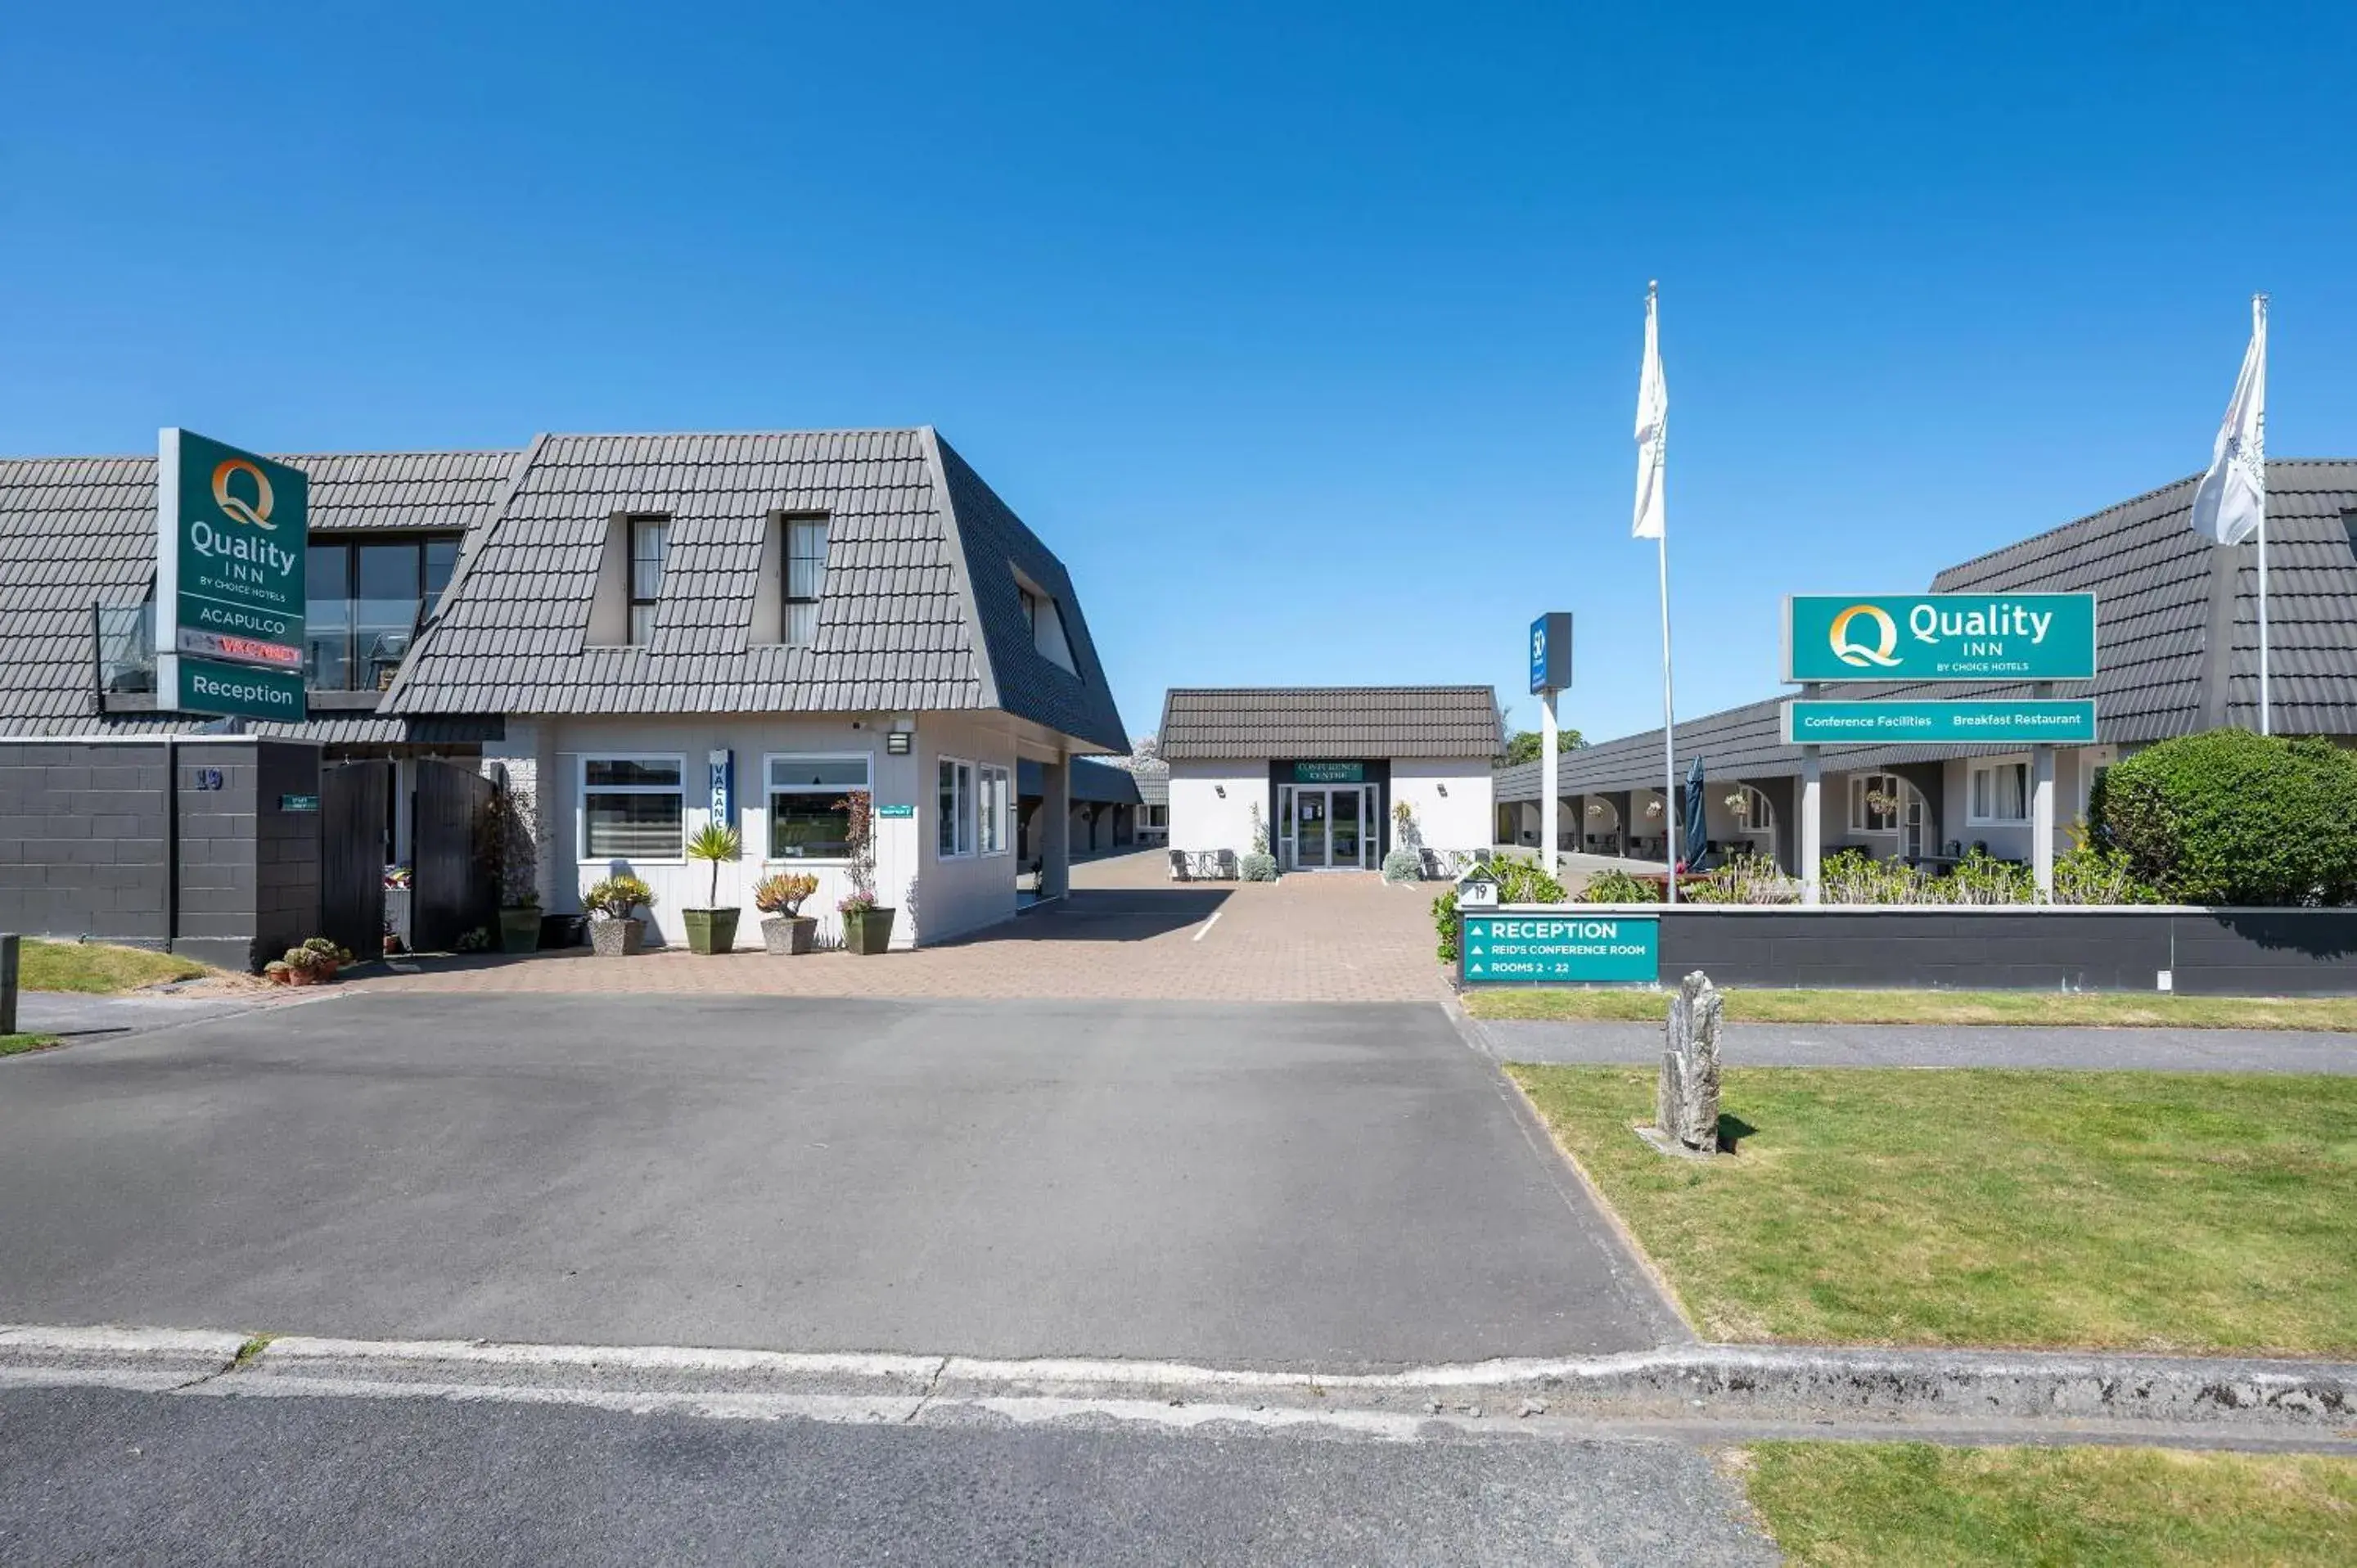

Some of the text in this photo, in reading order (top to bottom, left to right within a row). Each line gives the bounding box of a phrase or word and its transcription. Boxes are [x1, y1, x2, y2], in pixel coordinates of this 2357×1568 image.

[191, 520, 296, 576] Quality
[225, 561, 264, 583] INN
[200, 575, 286, 602] BY CHOICE HOTELS
[200, 607, 286, 634] ACAPULCO
[1909, 603, 2053, 644] Quality
[1963, 642, 2003, 656] INN
[1936, 662, 2030, 672] BY CHOICE HOTELS
[193, 675, 293, 705] Reception
[1805, 716, 1932, 727] Conference Facilities
[1954, 714, 2081, 726] Breakfast Restaurant
[714, 764, 724, 829] VACANC
[1476, 885, 1487, 899] 19
[1491, 922, 1617, 939] RECEPTION
[1491, 945, 1646, 955] REID'S CONFERENCE ROOM
[1491, 962, 1534, 972] ROOMS
[1535, 962, 1544, 972] 2
[1554, 962, 1569, 972] 22
